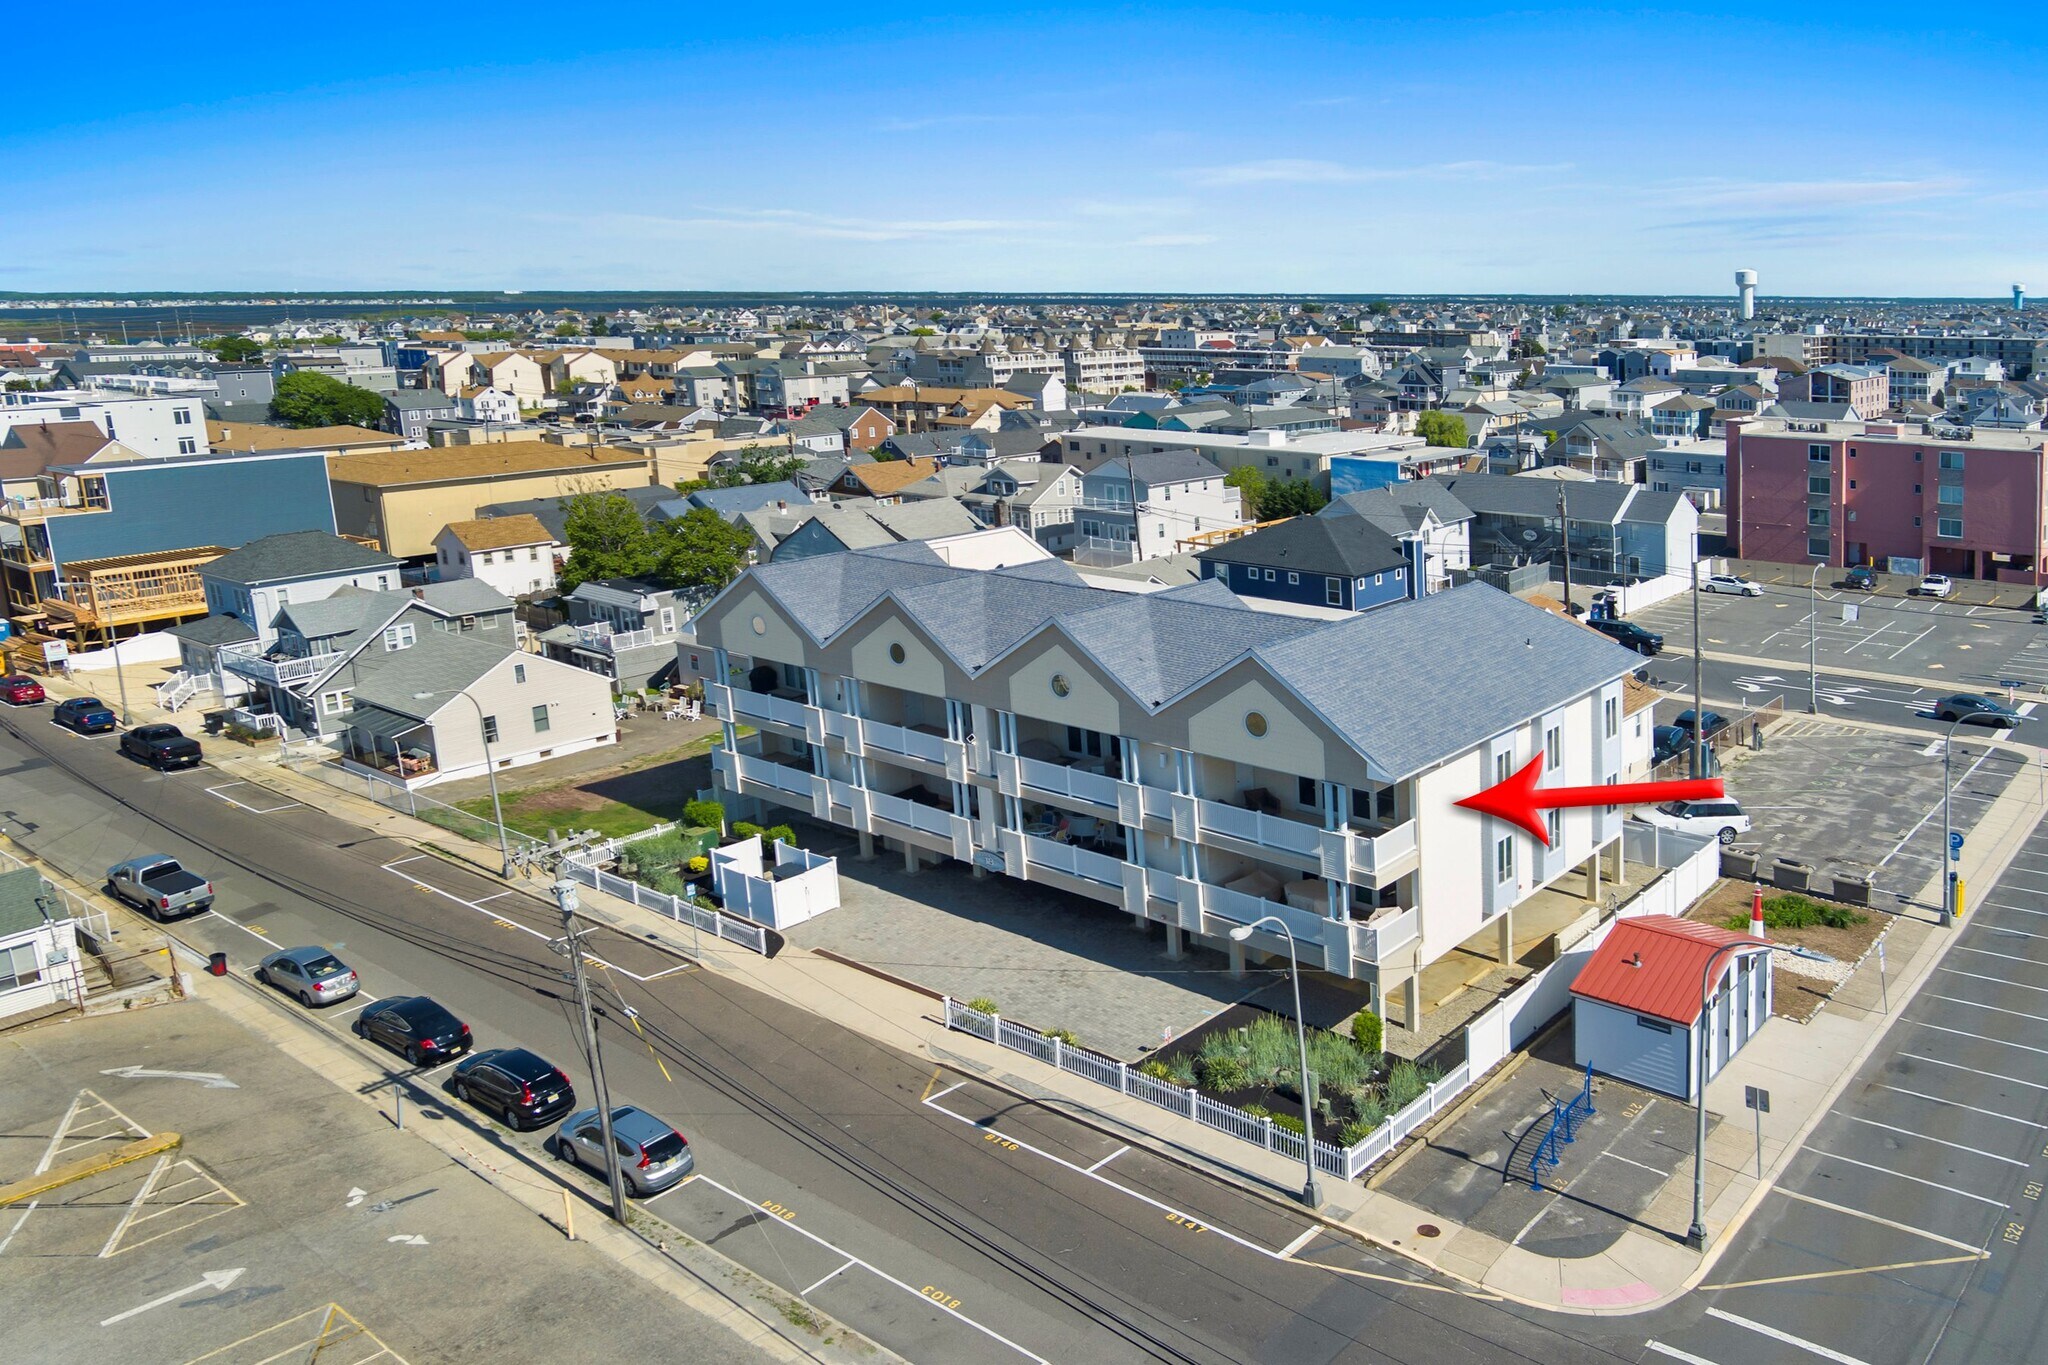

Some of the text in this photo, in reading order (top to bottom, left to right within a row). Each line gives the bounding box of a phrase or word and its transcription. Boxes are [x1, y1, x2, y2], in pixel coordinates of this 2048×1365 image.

[984, 1133, 1019, 1151] 8146
[2022, 1181, 2044, 1201] 1521
[761, 1200, 796, 1220] 8104
[1165, 1213, 1209, 1233] 8147
[2003, 1222, 2025, 1245] 1522
[921, 1286, 962, 1308] 8103
